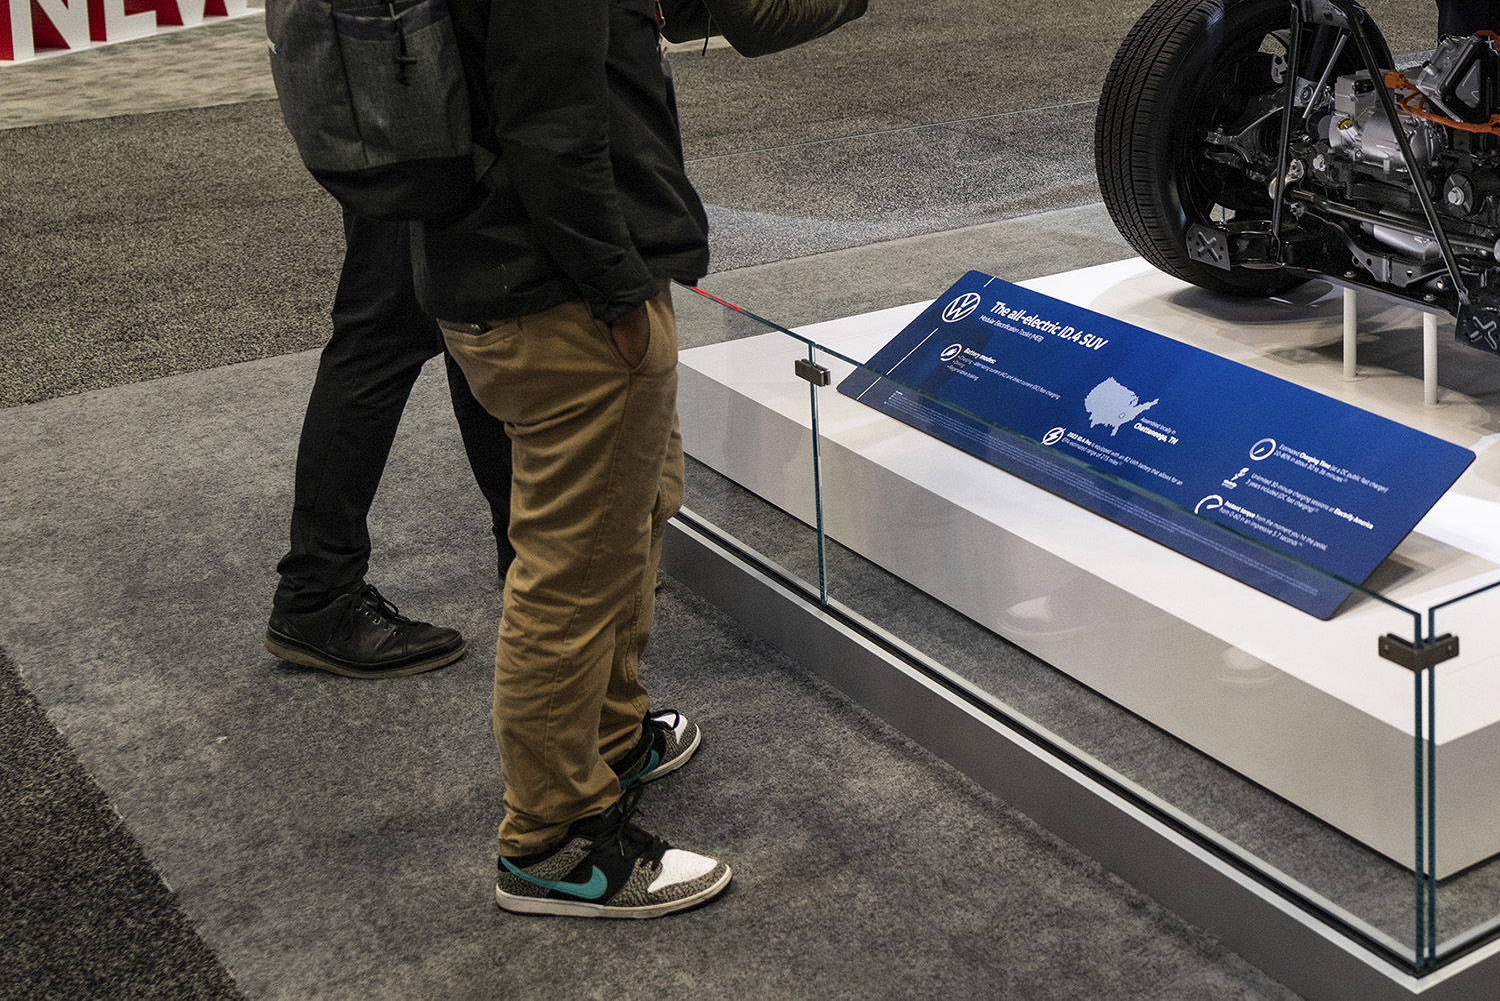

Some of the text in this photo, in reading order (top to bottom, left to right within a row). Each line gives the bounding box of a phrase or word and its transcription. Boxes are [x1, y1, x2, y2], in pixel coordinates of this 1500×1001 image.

[978, 314, 996, 324] Modular
[993, 319, 1020, 333] Electrification
[989, 300, 1109, 350] The all-electric ID.4 SUV
[963, 347, 996, 364] Battery modes:
[1133, 422, 1179, 445] Chattanooga, TN
[1298, 451, 1320, 466] Charging
[1223, 500, 1242, 512] Instant
[1332, 507, 1354, 522] Electrify
[1352, 515, 1374, 530] America
